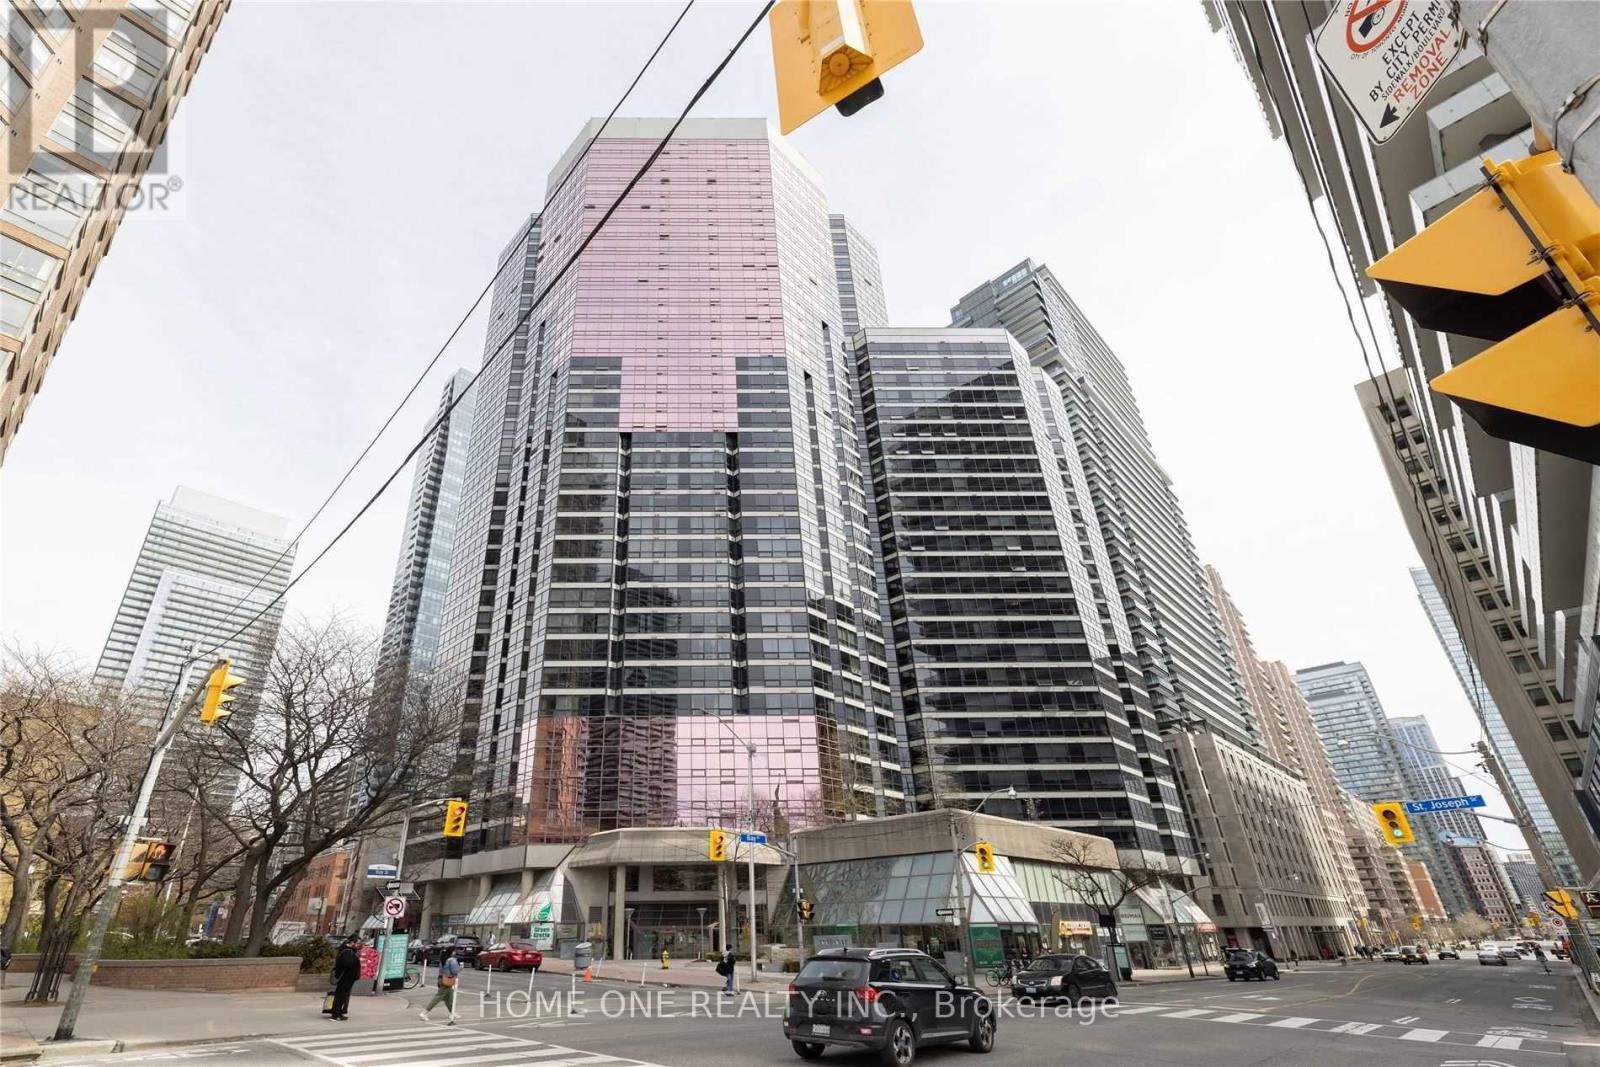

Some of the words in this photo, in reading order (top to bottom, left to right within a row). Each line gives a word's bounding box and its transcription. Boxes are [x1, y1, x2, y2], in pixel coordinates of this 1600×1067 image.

[1381, 7, 1446, 101] SIDEWALK/BOULEVARD
[1382, 10, 1421, 66] EXCEPT
[1392, 29, 1452, 104] REMOVAL
[1369, 80, 1385, 103] BY
[1386, 45, 1410, 79] CITY
[1409, 50, 1449, 101] ZONE
[1430, 798, 1470, 809] Joseph
